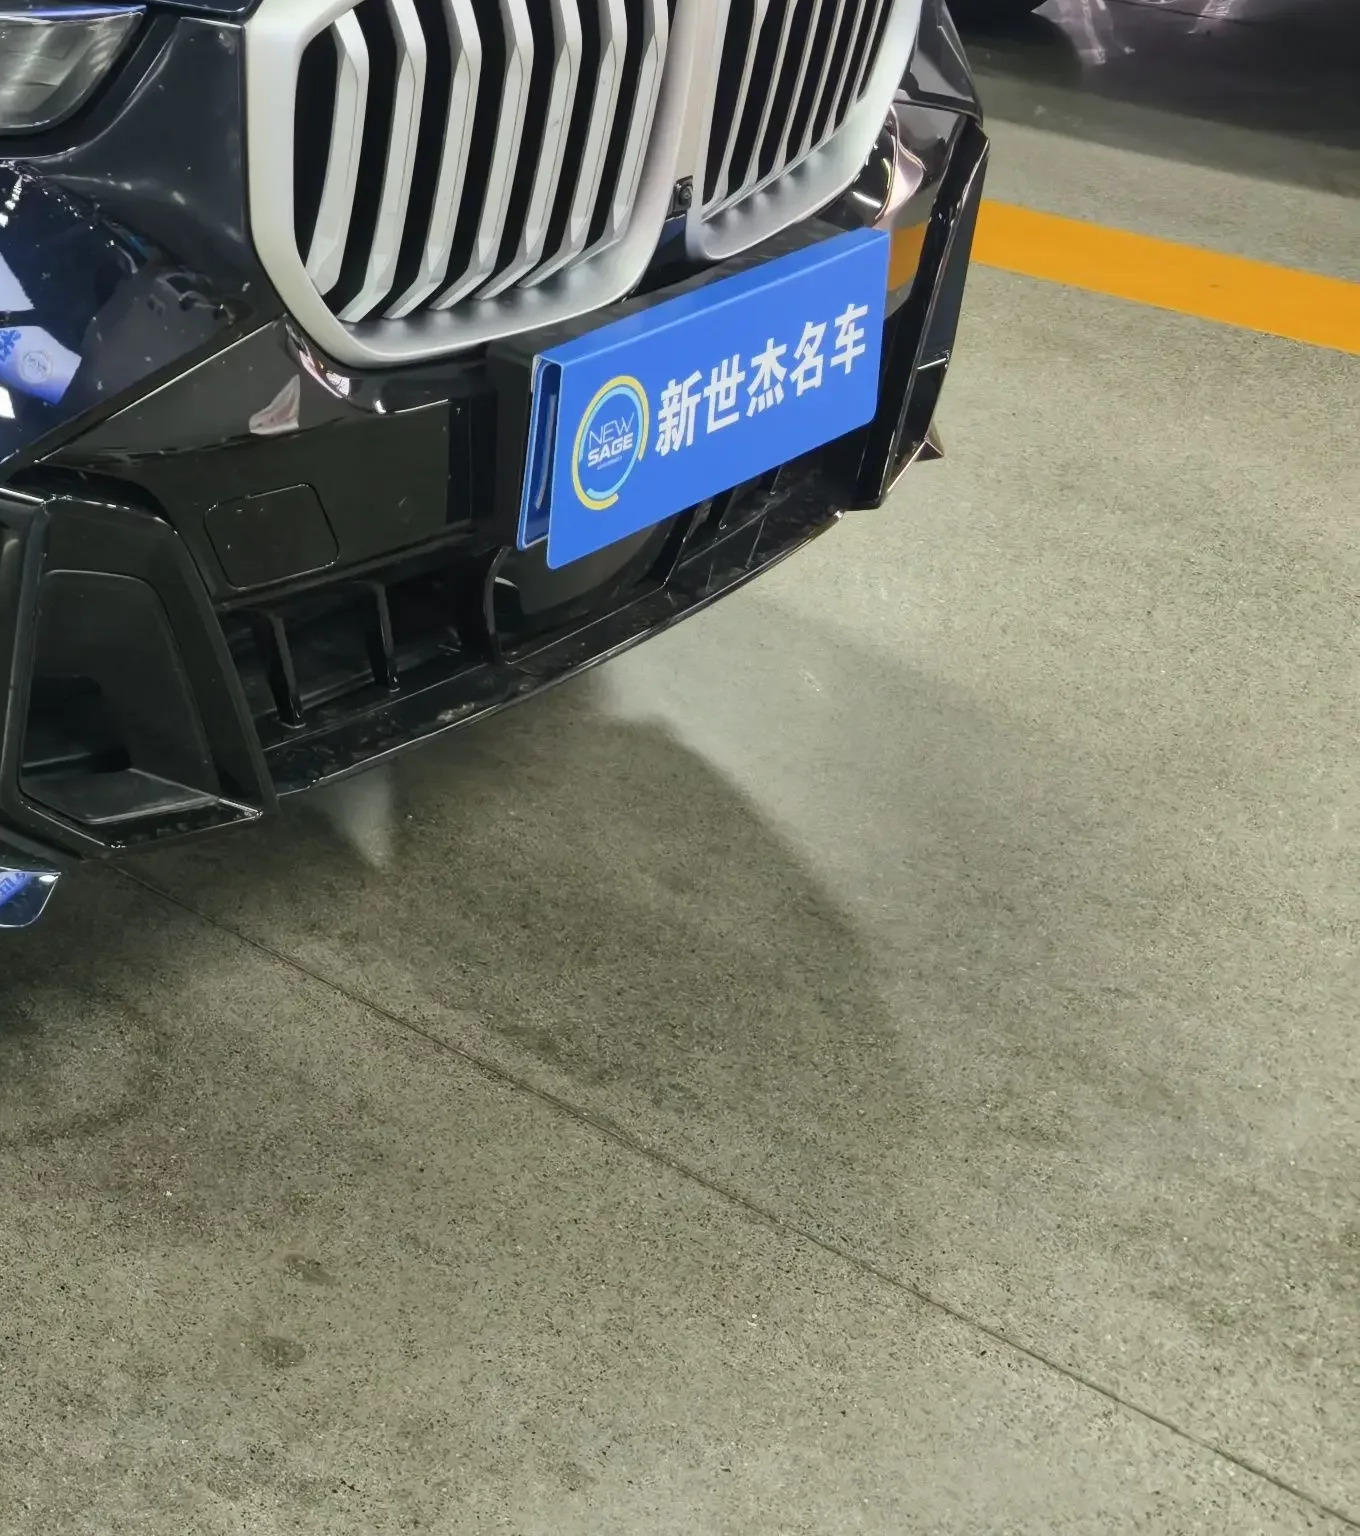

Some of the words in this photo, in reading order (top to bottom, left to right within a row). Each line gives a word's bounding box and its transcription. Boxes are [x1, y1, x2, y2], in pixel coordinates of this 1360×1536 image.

[654, 303, 869, 457] 新世杰名车
[588, 411, 635, 449] NEW
[587, 432, 634, 467] SAGE
